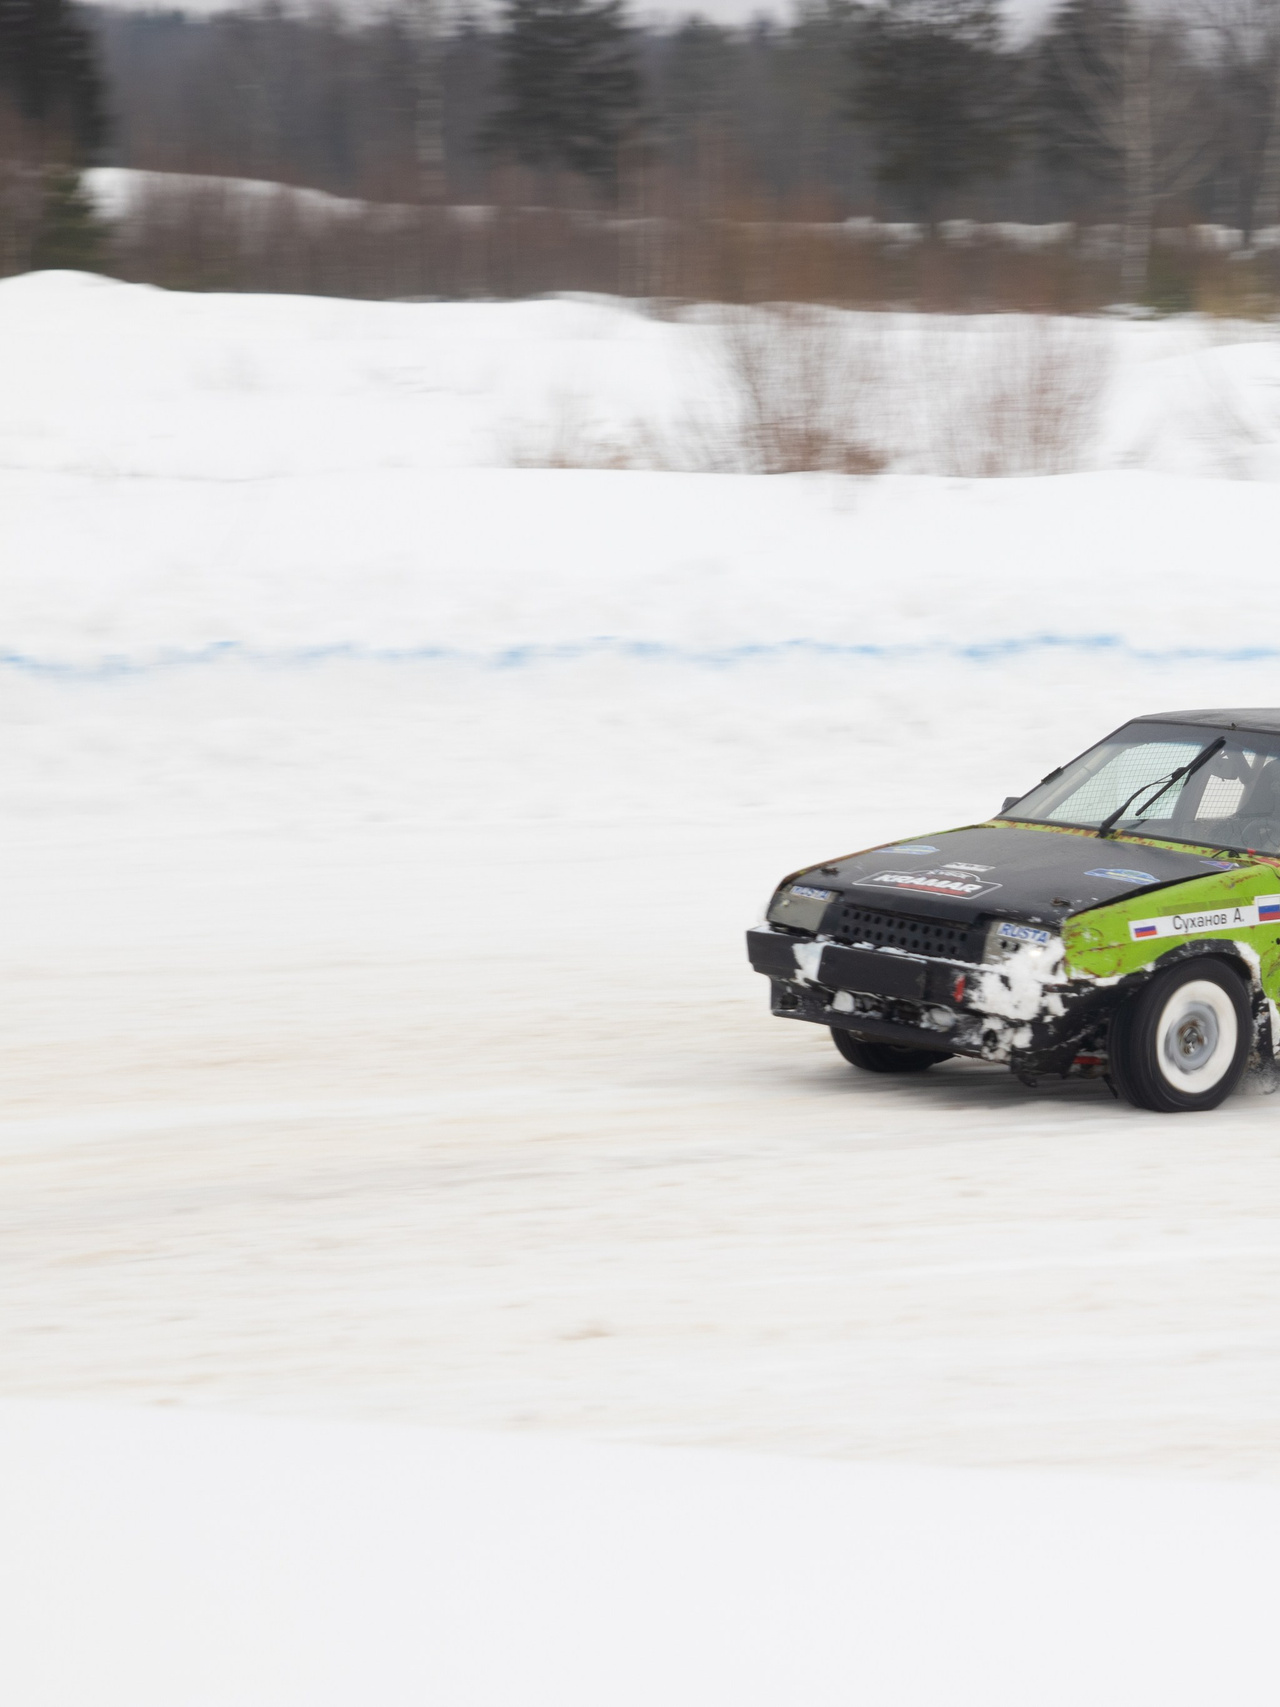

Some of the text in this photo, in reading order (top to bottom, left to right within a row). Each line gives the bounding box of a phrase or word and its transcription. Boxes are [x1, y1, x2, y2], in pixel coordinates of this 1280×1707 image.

[873, 874, 983, 893] KRAMAR
[1173, 913, 1227, 932] Суханов
[1002, 923, 1048, 943] RUSTA
